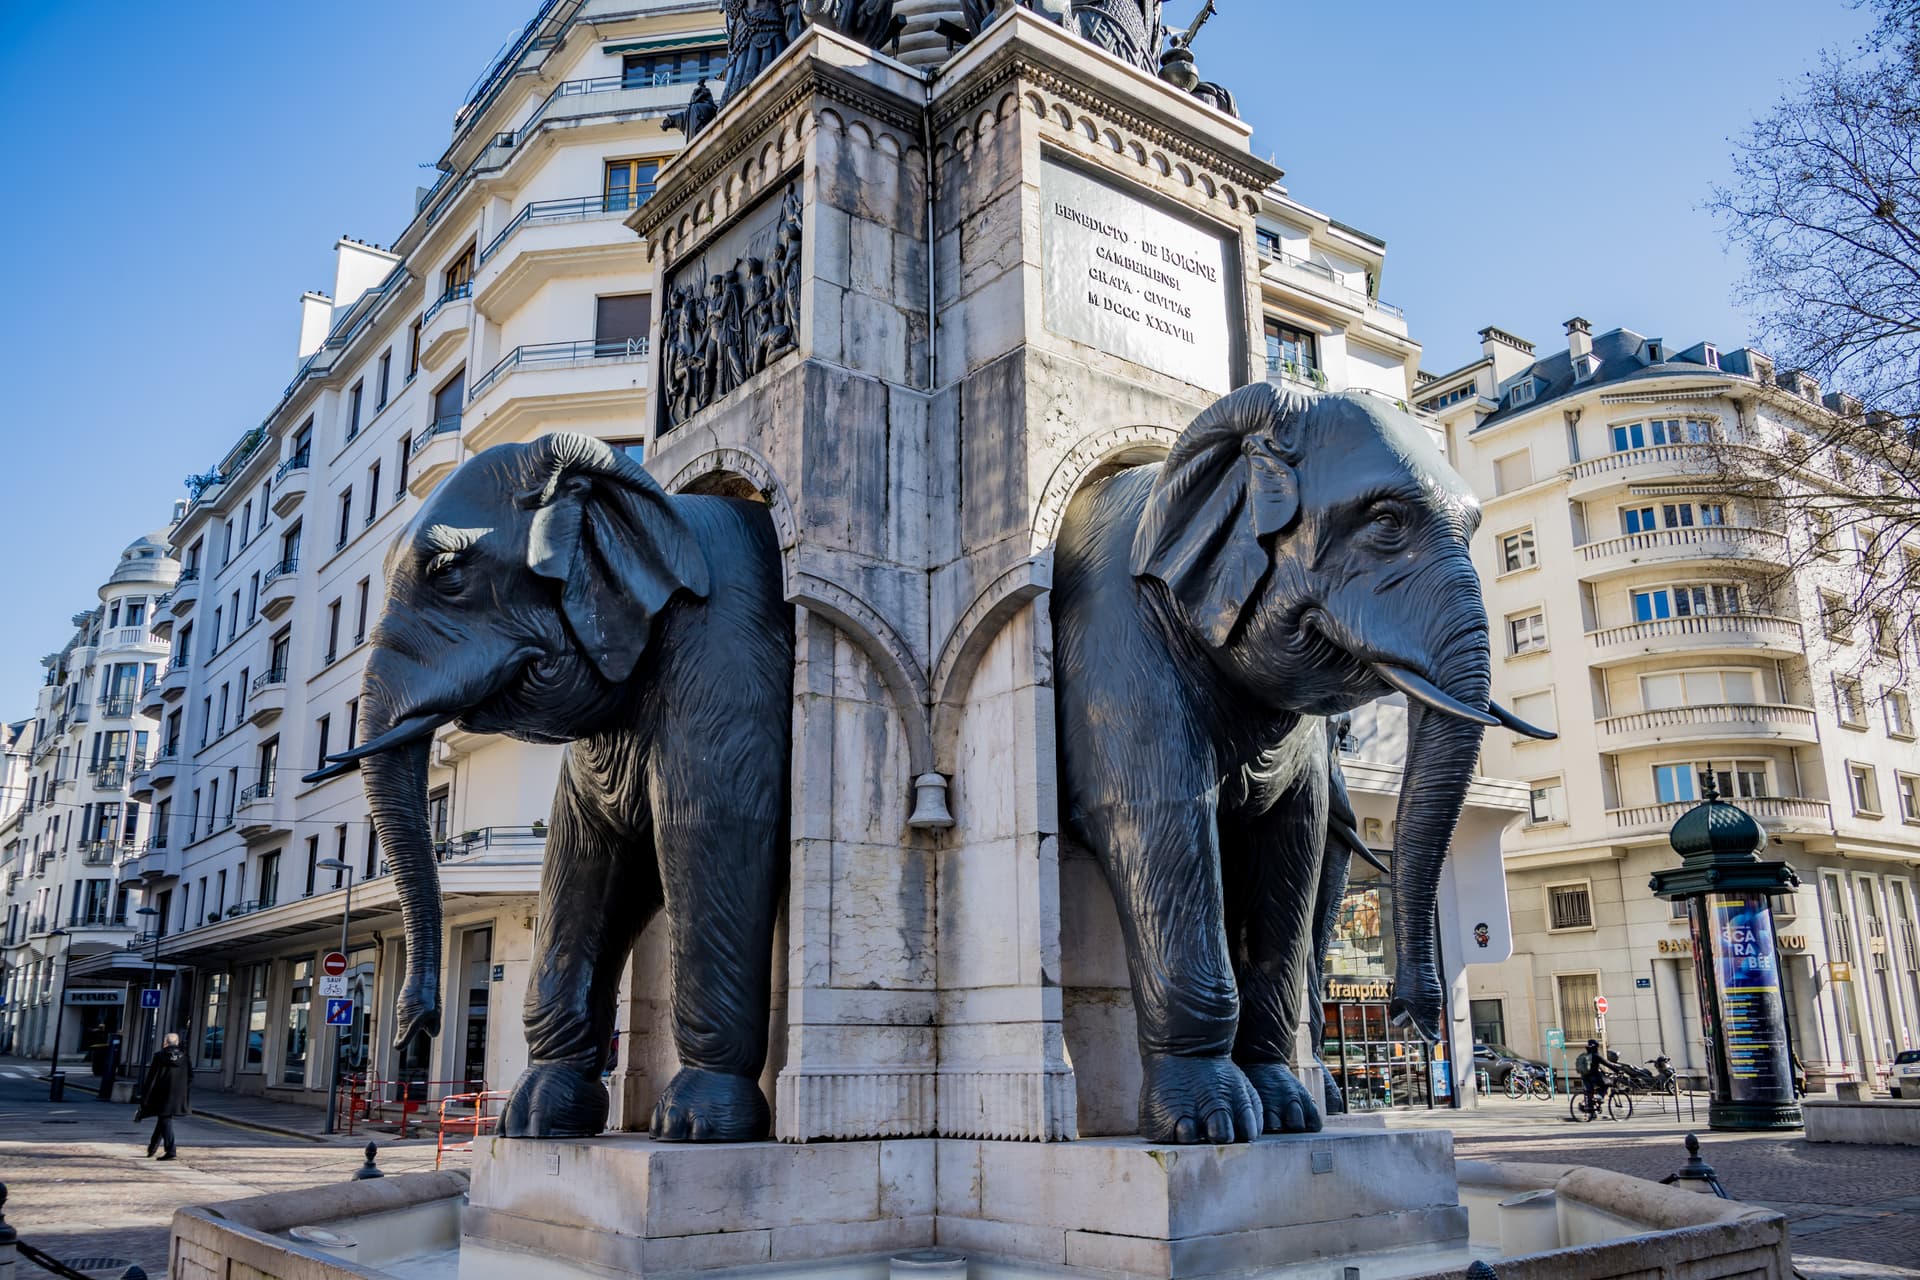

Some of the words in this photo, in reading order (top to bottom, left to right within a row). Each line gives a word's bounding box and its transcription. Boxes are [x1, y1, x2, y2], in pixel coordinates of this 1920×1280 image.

[1055, 202, 1128, 243] BENEDICTO
[1141, 239, 1158, 257] DE
[1161, 246, 1217, 283] BOIGNE
[1096, 246, 1181, 291] CAMBERIENSI
[1088, 267, 1132, 294] GRATA
[1143, 289, 1191, 319] CIVITAS
[1088, 291, 1100, 307] M
[1103, 297, 1140, 322] DCCC
[1145, 313, 1195, 345] XXXVIII
[1658, 938, 1692, 953] BAN
[1328, 979, 1389, 1001] franprix
